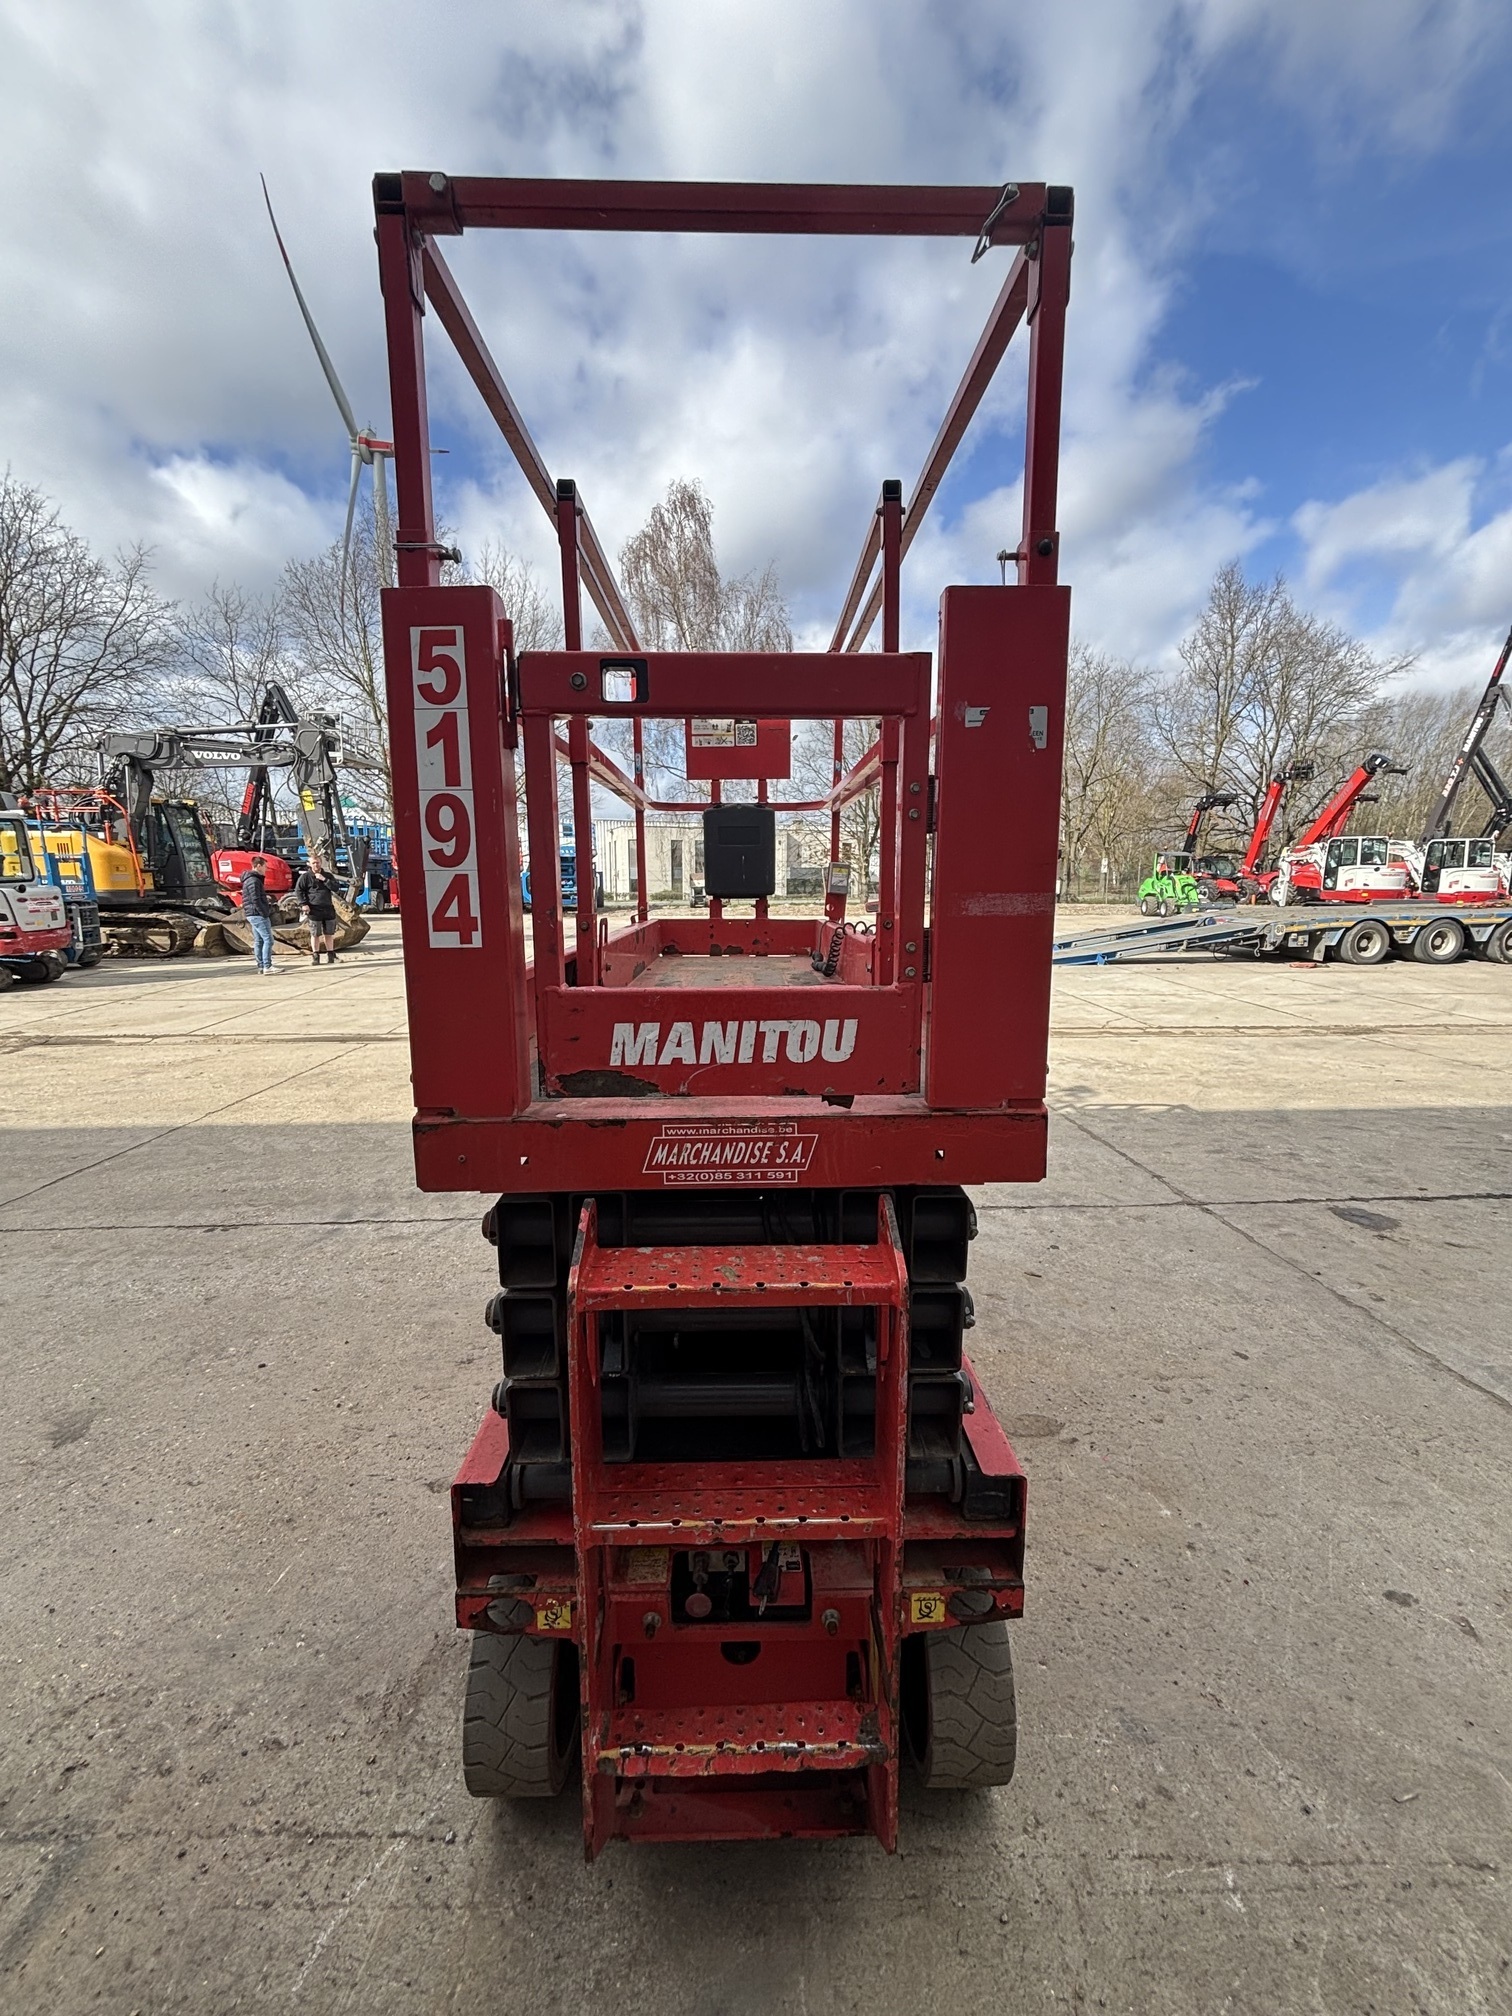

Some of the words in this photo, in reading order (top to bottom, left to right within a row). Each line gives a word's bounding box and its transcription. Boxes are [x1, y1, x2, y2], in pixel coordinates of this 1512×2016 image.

[1462, 716, 1484, 753] MANITOU
[191, 750, 241, 761] VOLVO
[241, 782, 256, 816] MANITOU
[416, 628, 479, 945] 5194
[609, 1018, 859, 1067] MANITOU
[666, 1126, 794, 1136] www.marchandise.be
[651, 1141, 774, 1166] MARCHANDISE
[775, 1141, 806, 1164] S.A.
[667, 1172, 733, 1182] +32(0)85
[736, 1171, 761, 1180] 311
[766, 1171, 792, 1180] 591
